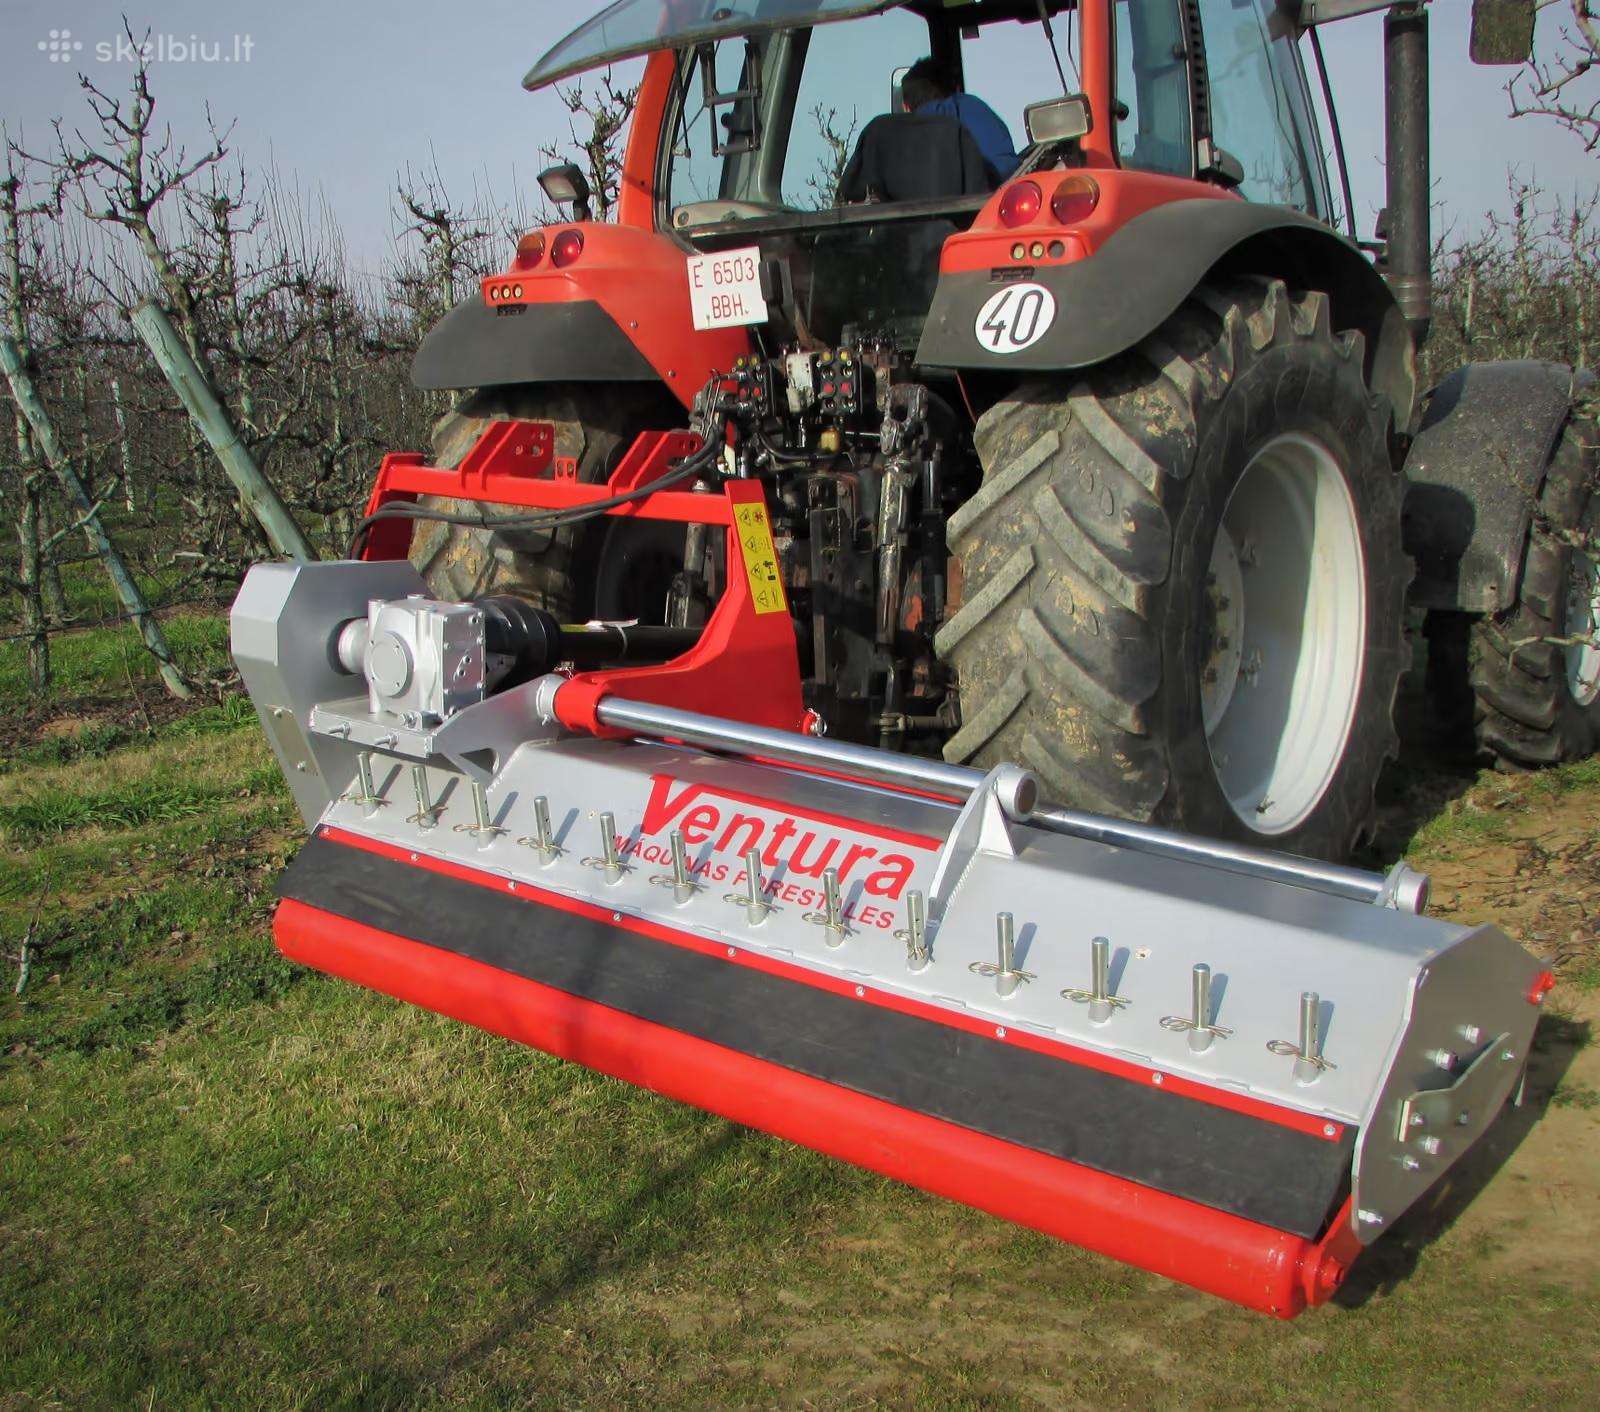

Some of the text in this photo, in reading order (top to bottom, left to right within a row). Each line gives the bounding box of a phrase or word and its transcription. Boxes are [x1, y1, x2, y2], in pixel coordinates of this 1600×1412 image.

[693, 257, 755, 288] E 6503
[711, 293, 744, 319] BBH
[982, 289, 1044, 346] 40
[639, 774, 915, 901] Ventura
[614, 835, 895, 929] MÁQUNAS FRESTLES
